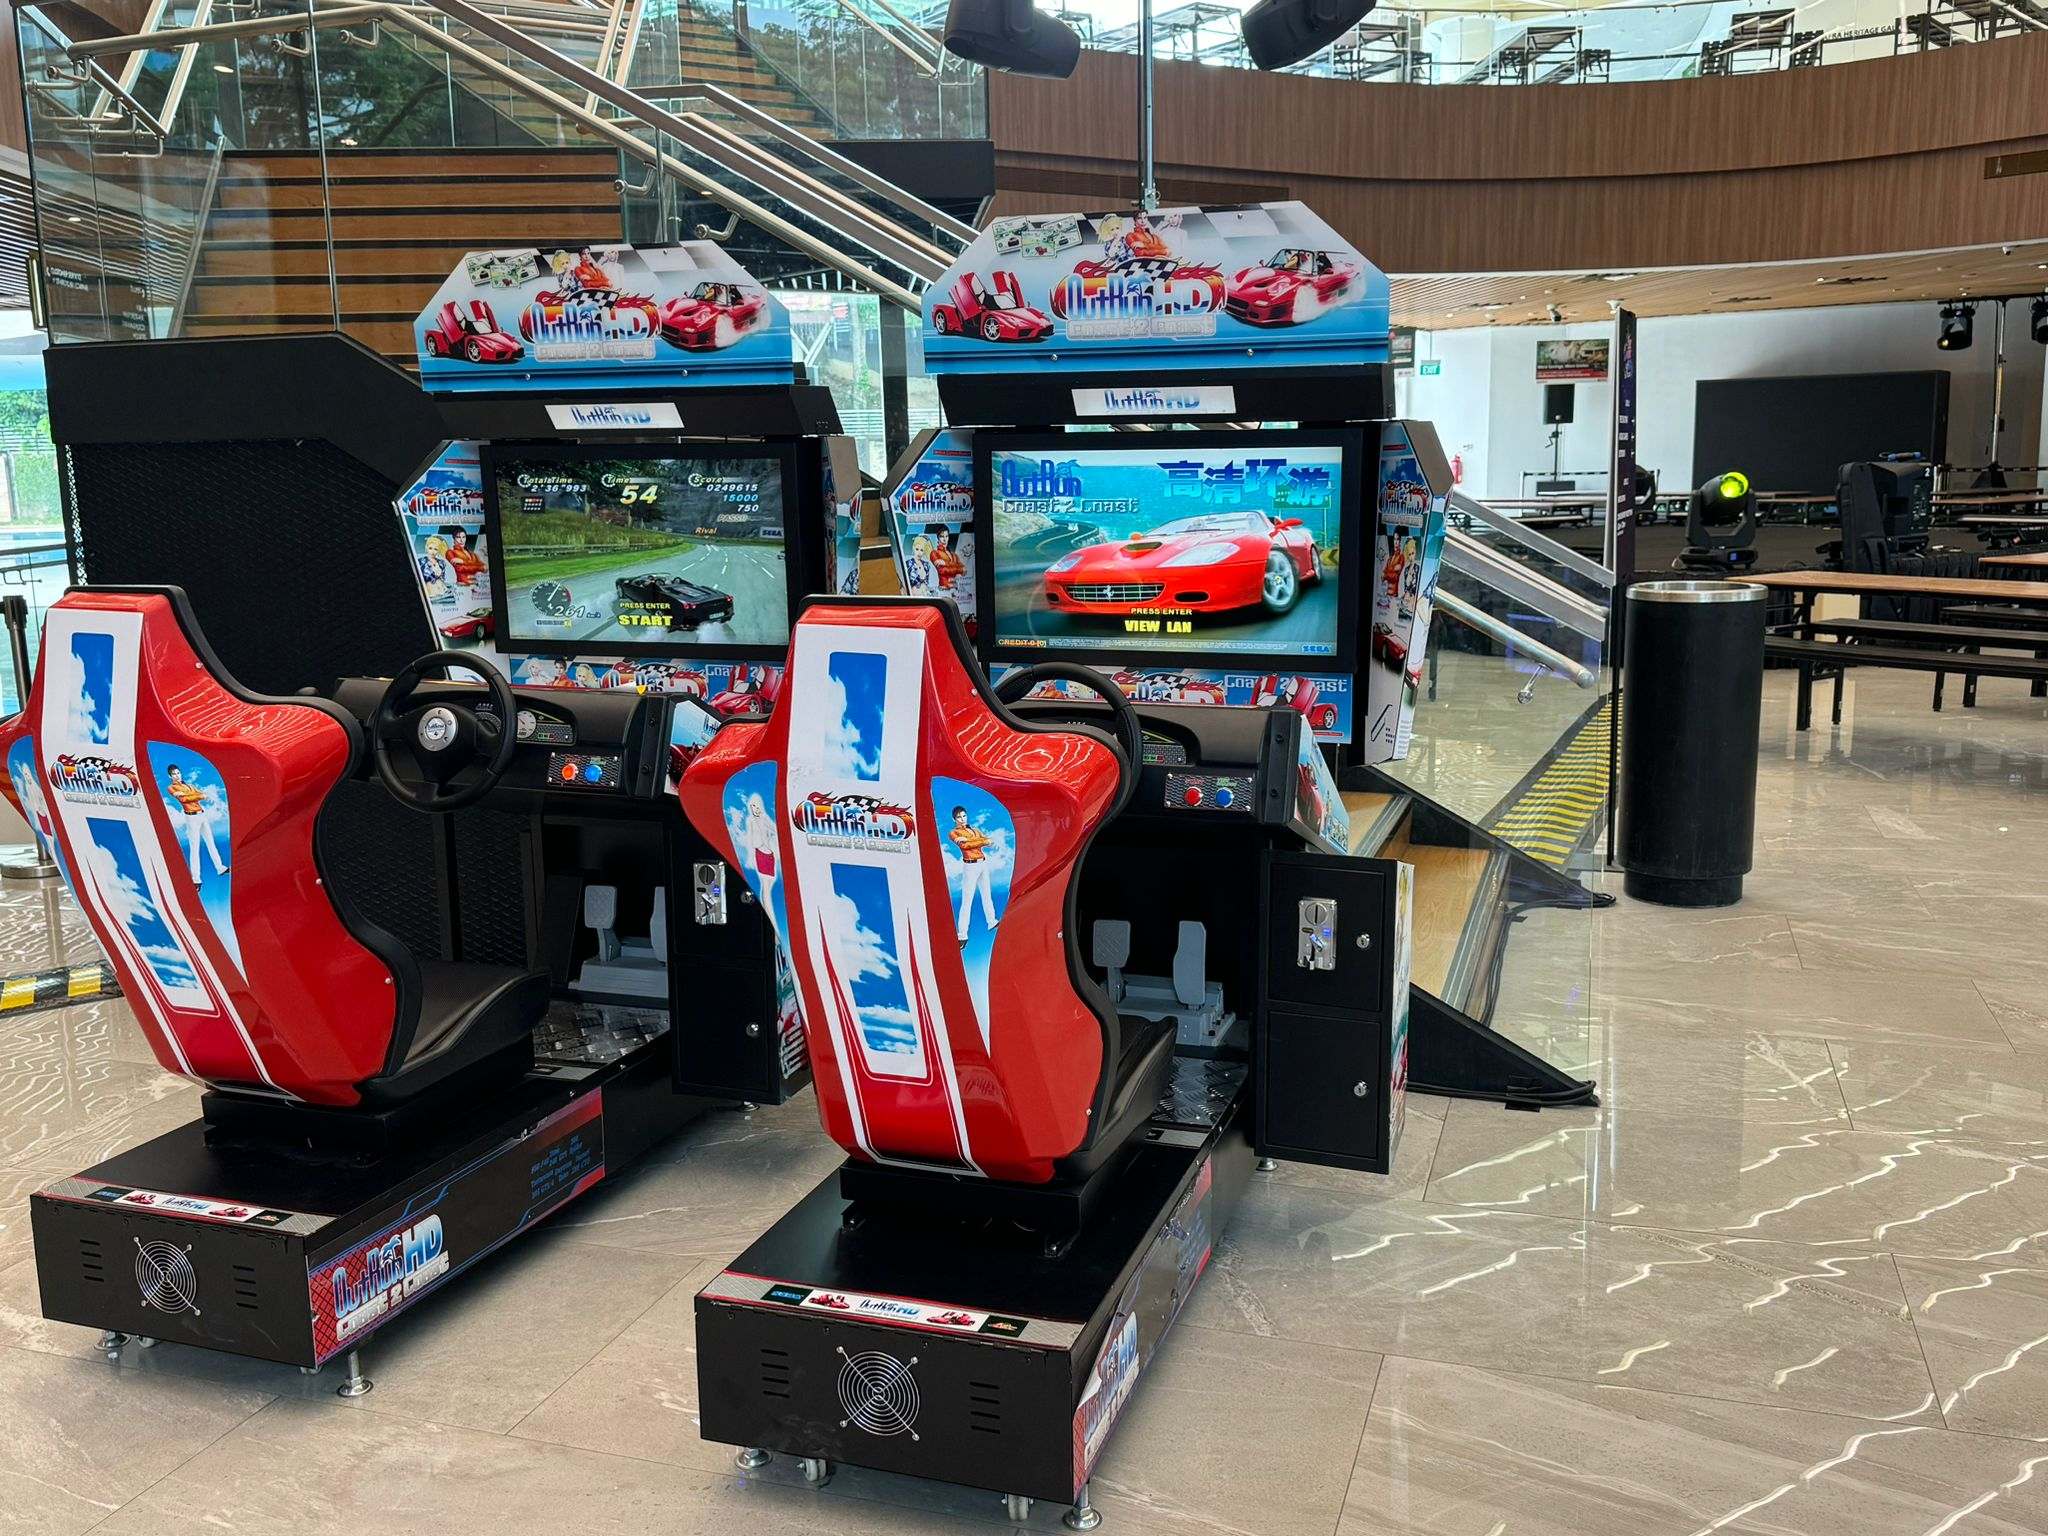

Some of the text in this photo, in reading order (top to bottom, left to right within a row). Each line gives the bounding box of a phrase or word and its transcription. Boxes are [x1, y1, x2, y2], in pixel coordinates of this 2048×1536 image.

[1844, 27, 1880, 37] HERITAGE
[1155, 279, 1216, 316] HD
[1001, 459, 1082, 497] OutRun
[1157, 458, 1334, 506] 高清环游
[706, 484, 759, 492] 0249615
[619, 484, 659, 505] 54
[723, 494, 759, 502] 15000
[737, 504, 760, 512] 750
[695, 527, 718, 535] Rival
[762, 529, 783, 538] SEGA
[619, 602, 671, 610] PRESS ENTER
[1130, 607, 1193, 616] PRESS ENTER
[618, 614, 674, 627] START
[1124, 619, 1193, 634] VIEW LAN
[1302, 645, 1330, 654] SEGA
[865, 811, 906, 840] HD
[333, 1214, 443, 1318] OutRun HD
